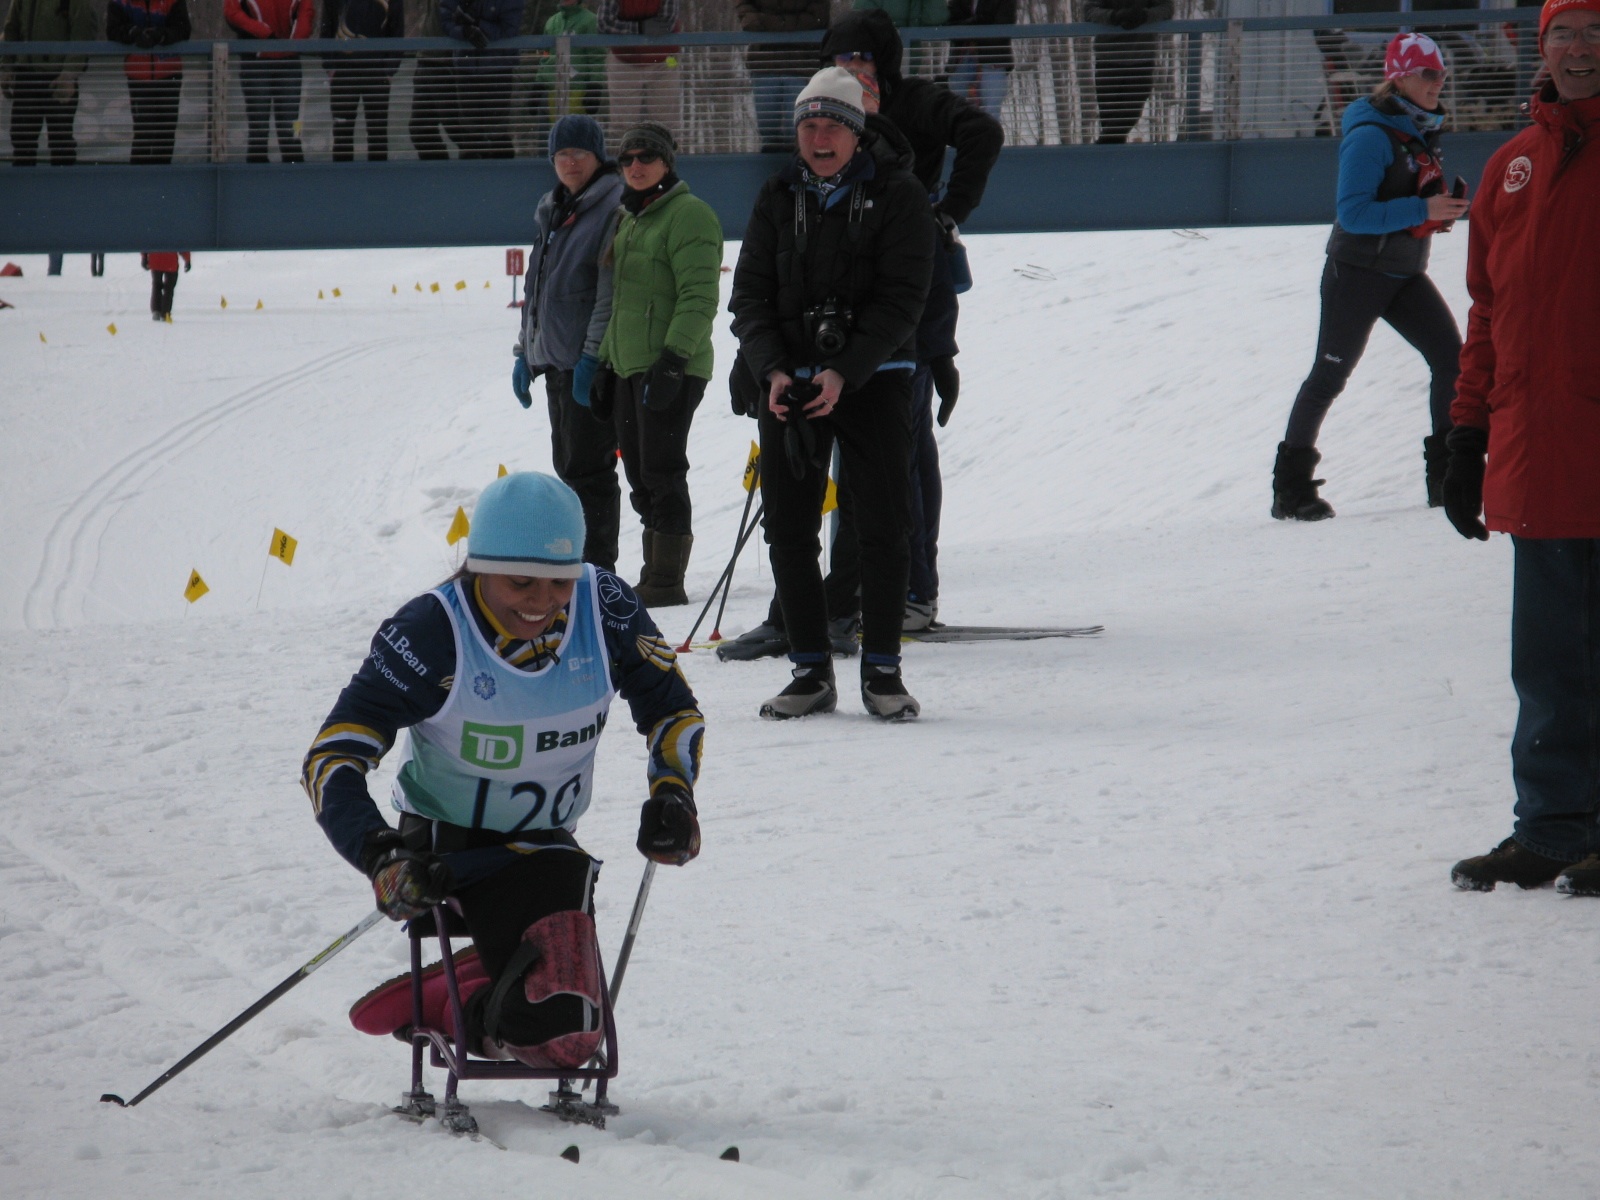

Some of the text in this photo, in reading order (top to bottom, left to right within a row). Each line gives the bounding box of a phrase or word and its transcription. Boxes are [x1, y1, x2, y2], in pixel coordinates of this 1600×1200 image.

[467, 711, 607, 765] TD Bank
[470, 773, 582, 835] 120
